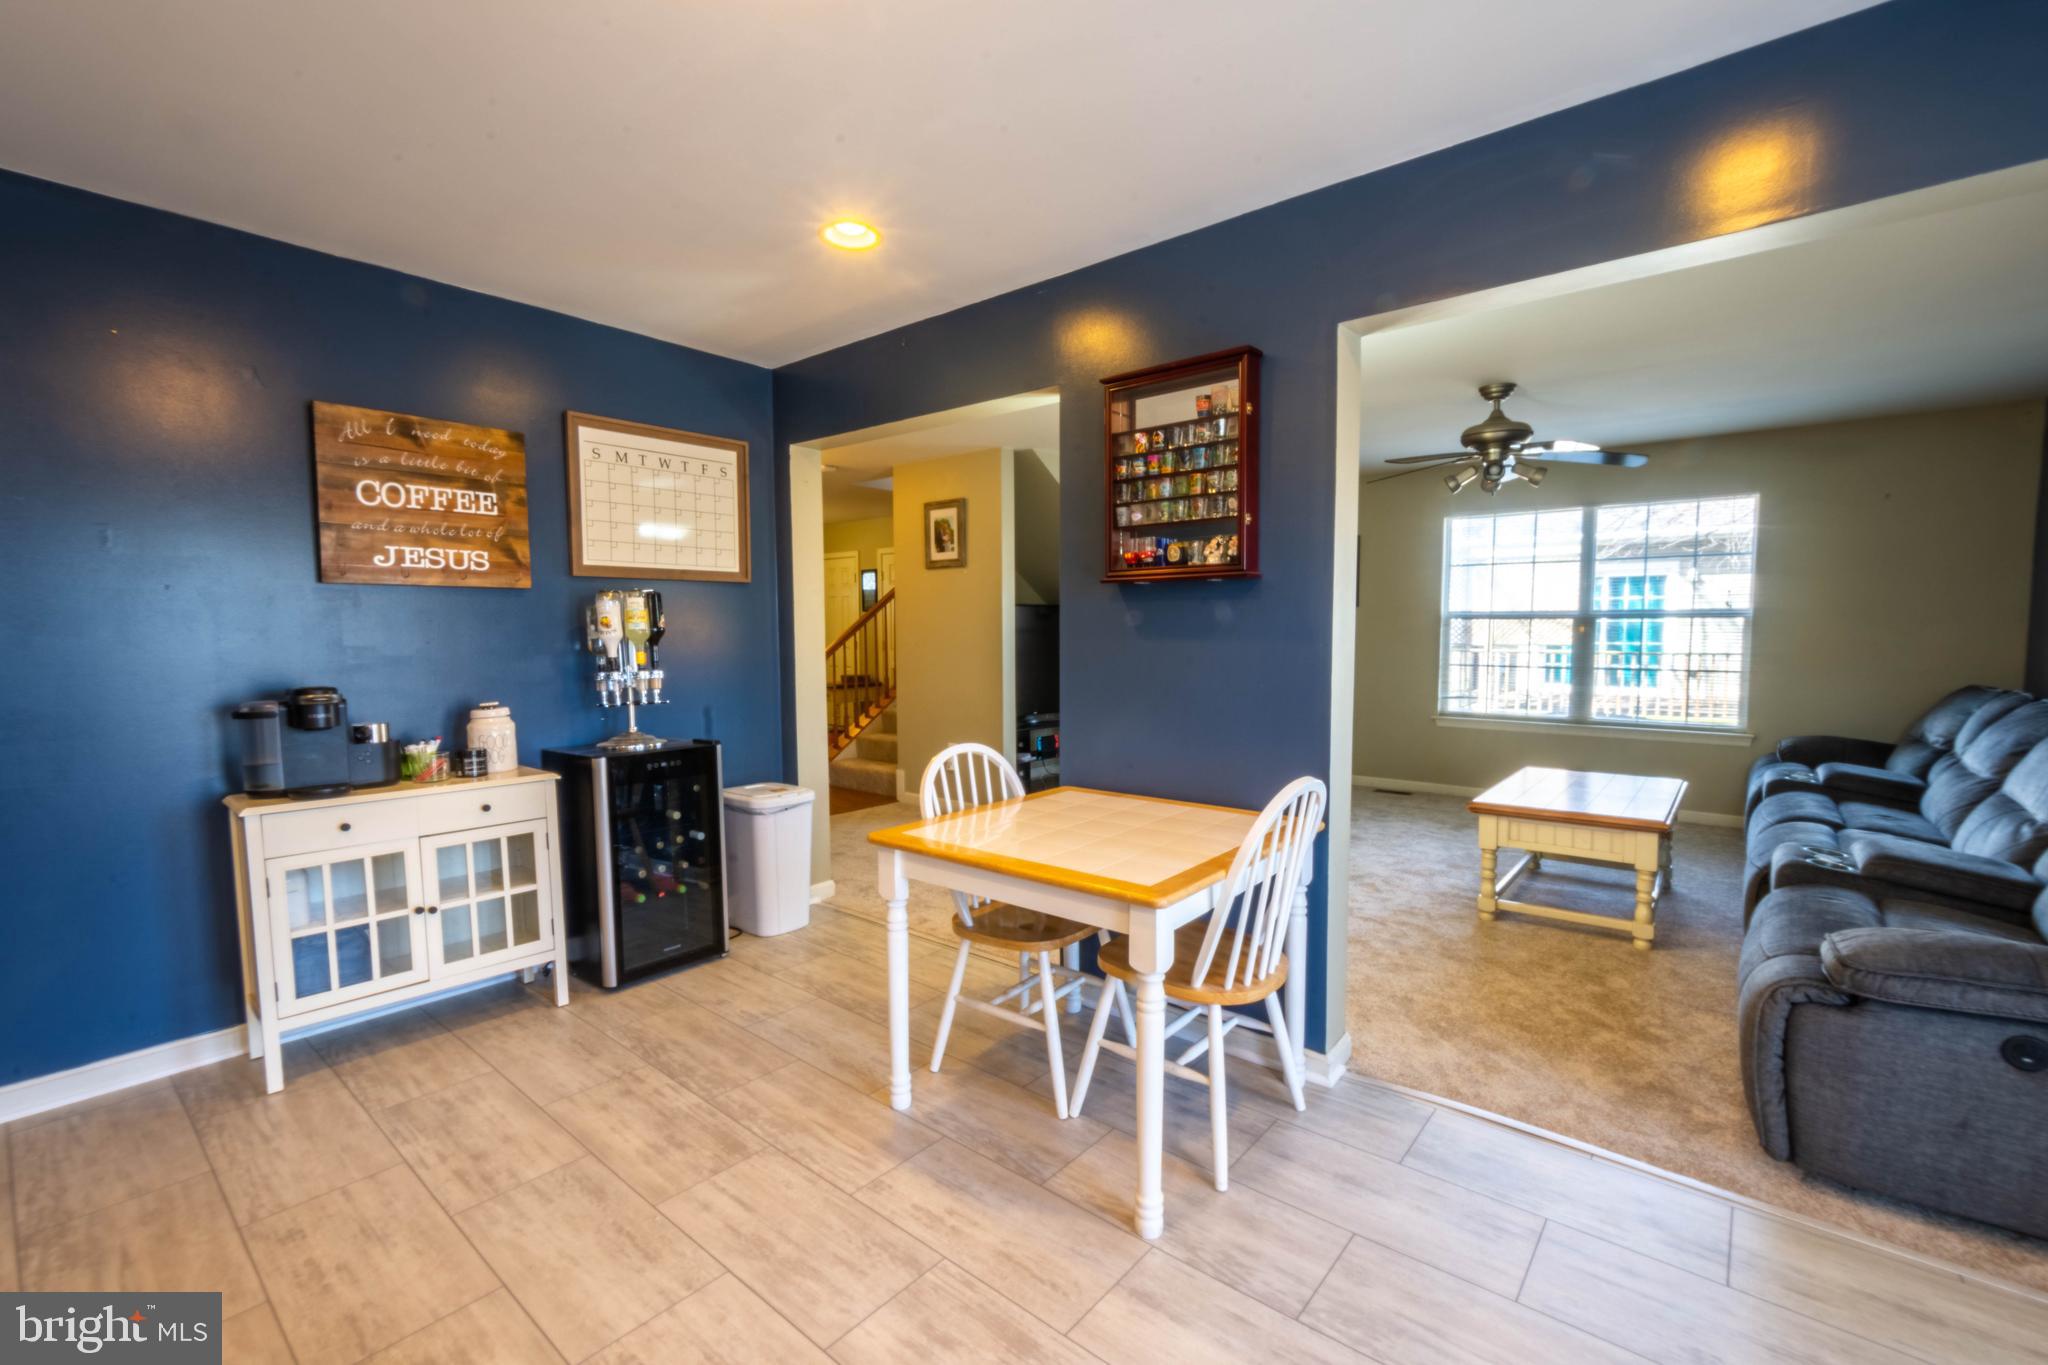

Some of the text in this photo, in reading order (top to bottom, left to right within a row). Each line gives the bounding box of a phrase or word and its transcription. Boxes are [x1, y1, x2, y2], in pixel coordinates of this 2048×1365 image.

[338, 419, 372, 443] All
[411, 428, 453, 442] need
[591, 447, 728, 478] S M T W T F S
[356, 480, 499, 516] COFFEE
[351, 518, 391, 533] and
[410, 521, 457, 537] whole
[373, 545, 490, 572] JESUS
